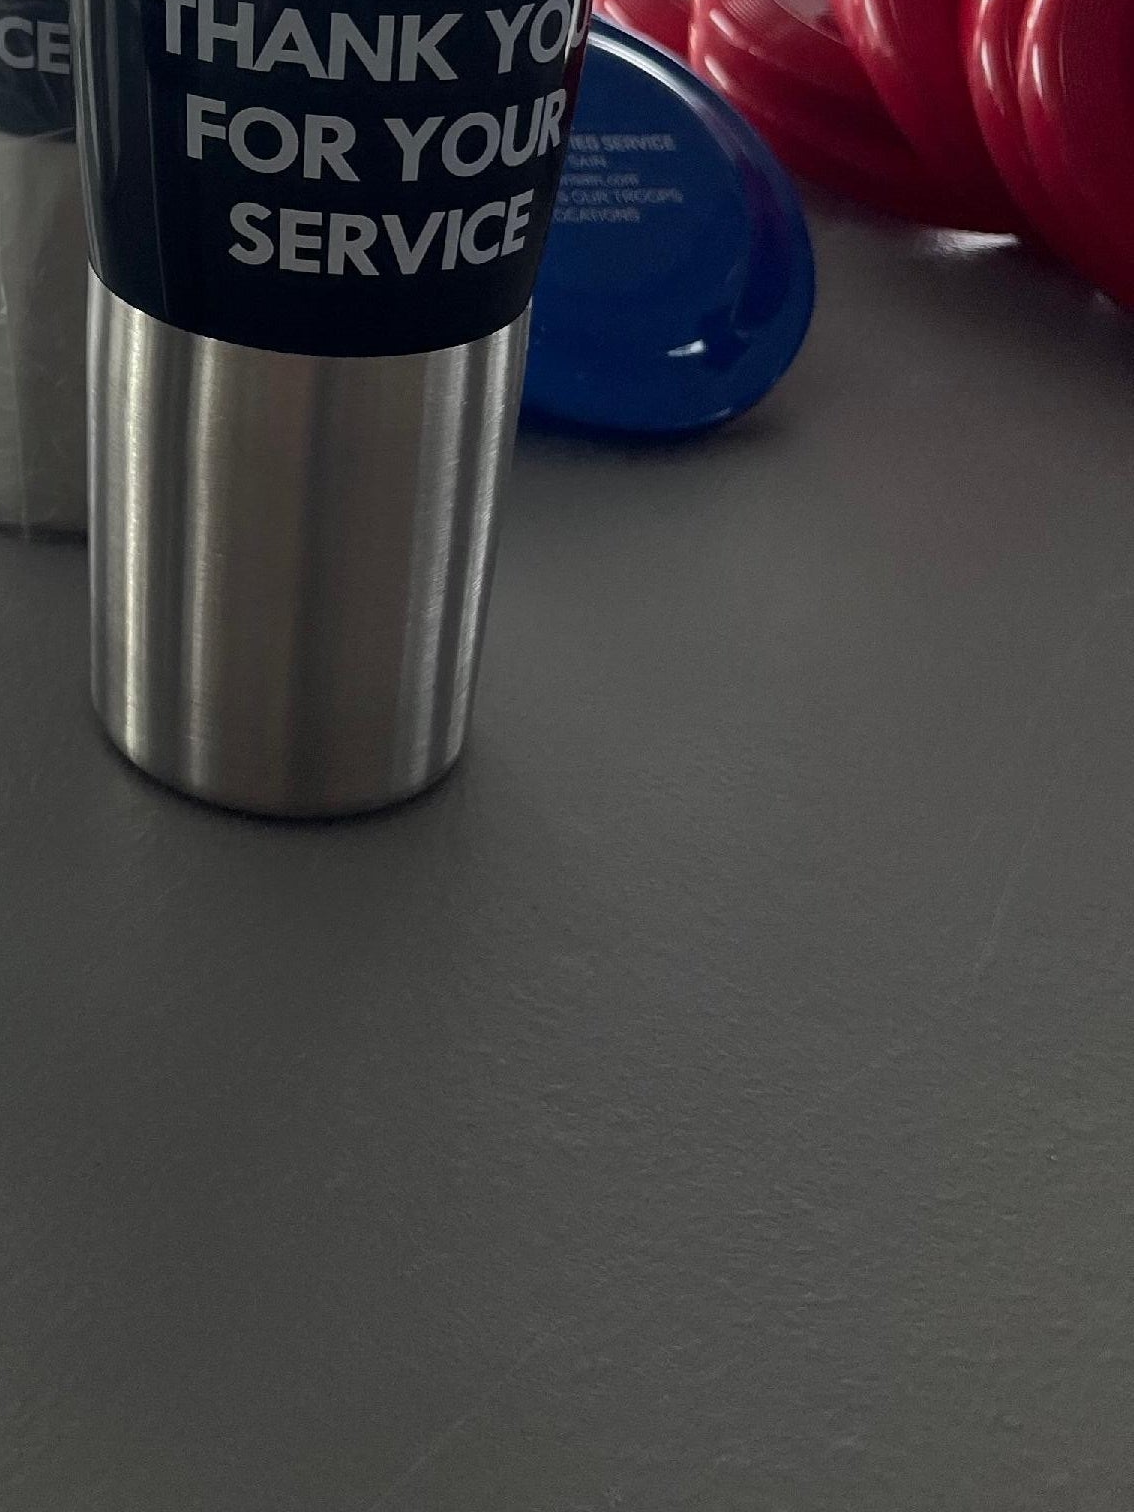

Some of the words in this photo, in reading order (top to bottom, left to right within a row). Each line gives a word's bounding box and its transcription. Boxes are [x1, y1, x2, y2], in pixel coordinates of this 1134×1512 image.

[186, 94, 361, 183] FOR
[384, 88, 567, 182] YOUR
[229, 189, 534, 276] SERVICE
